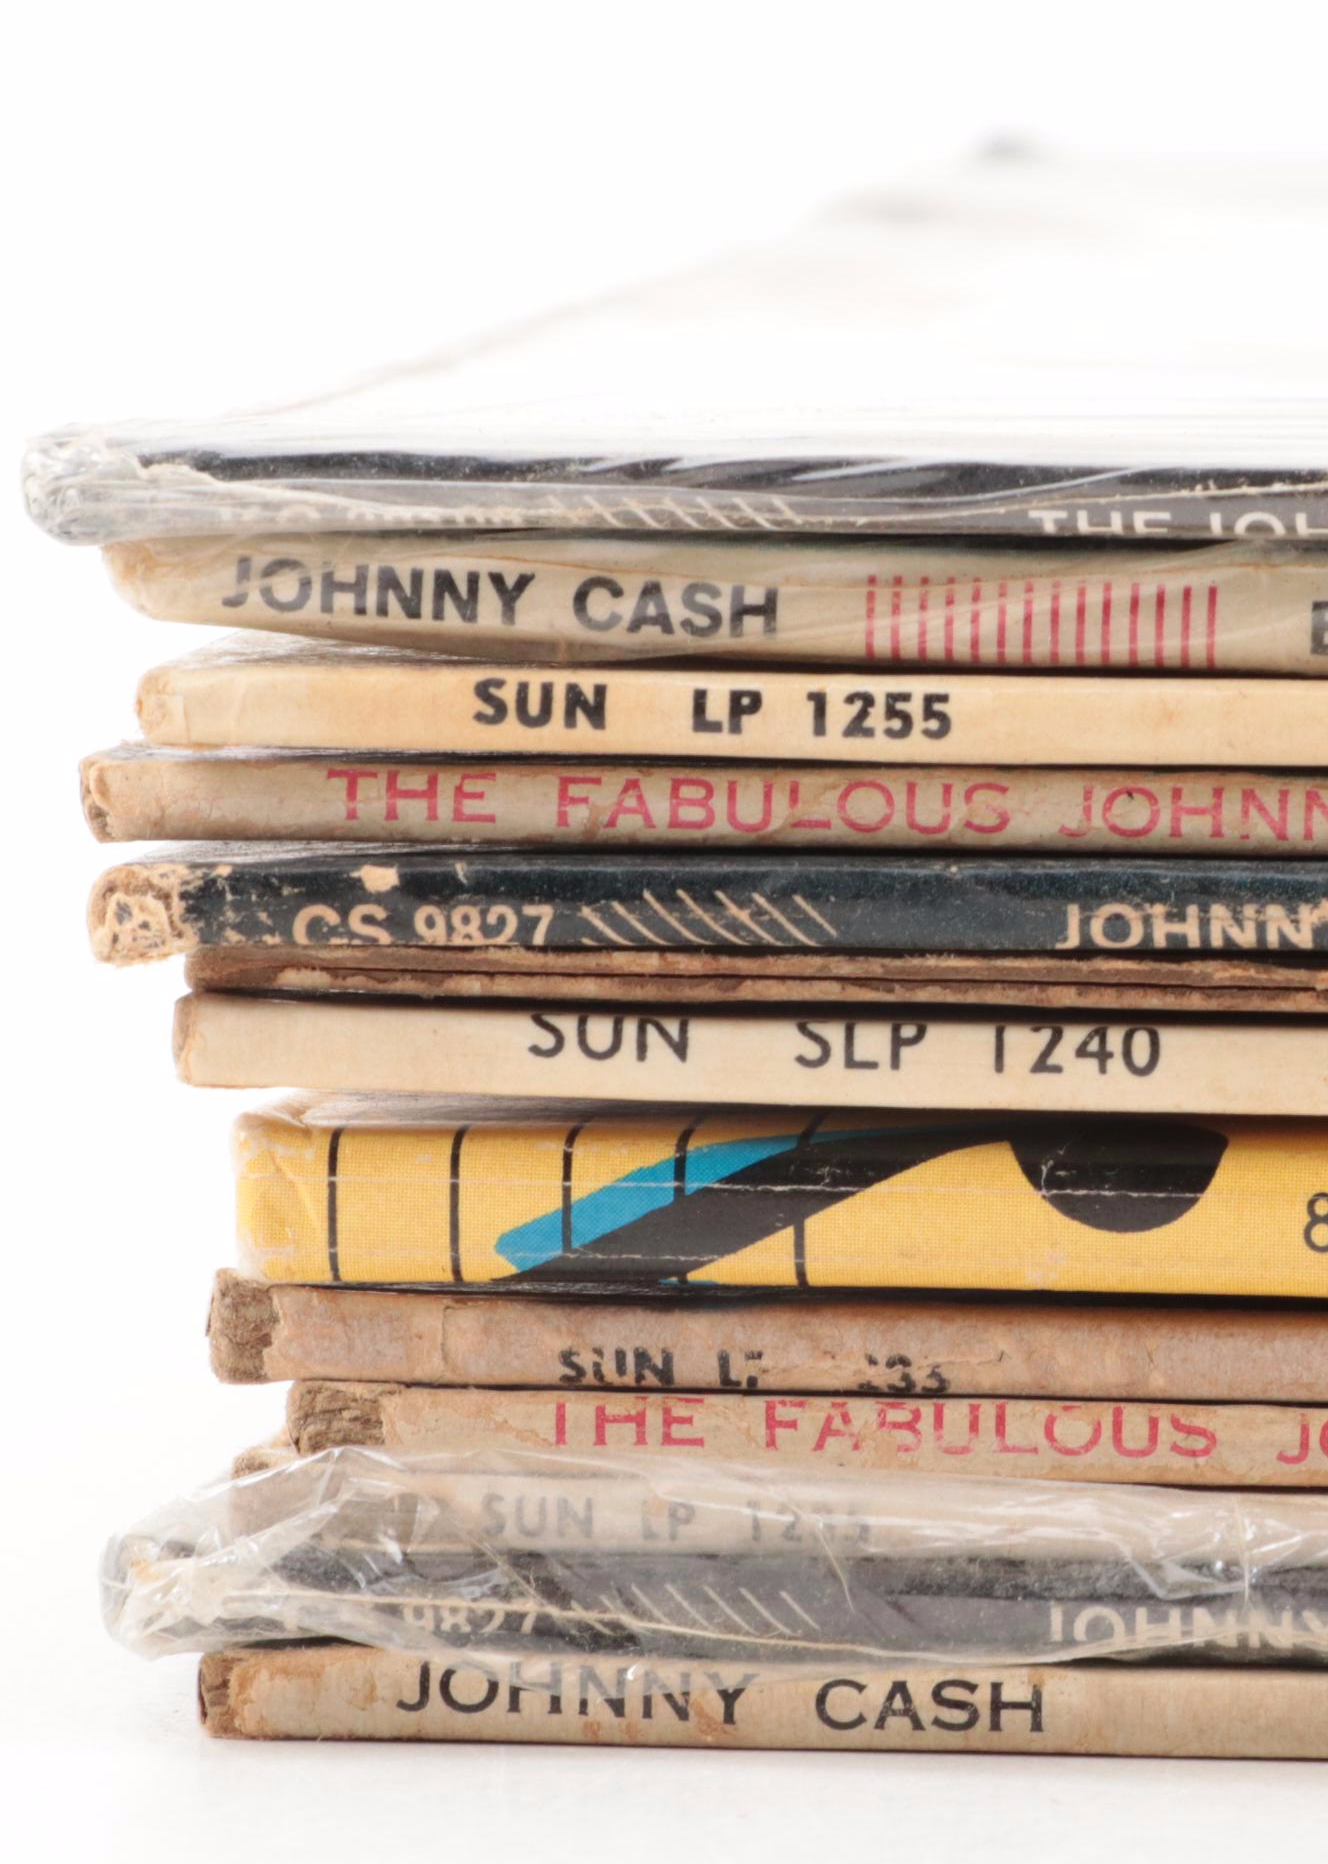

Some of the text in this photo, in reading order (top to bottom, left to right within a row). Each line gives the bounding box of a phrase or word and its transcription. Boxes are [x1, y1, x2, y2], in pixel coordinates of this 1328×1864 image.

[221, 555, 536, 627] JOHNNY
[572, 576, 779, 640] CASH
[472, 678, 953, 741] SUN LP 1255
[326, 768, 497, 825] THE
[554, 774, 1011, 836] FABULOUS
[291, 903, 393, 946] CS
[413, 903, 555, 947] 9827
[527, 1012, 1162, 1078] SUN SLP 1240
[552, 1396, 706, 1450] THE
[763, 1399, 1220, 1459] FABULOUS
[480, 1492, 596, 1540] SUN
[395, 1661, 760, 1725] JOHNNY
[814, 1678, 1046, 1734] CASH
